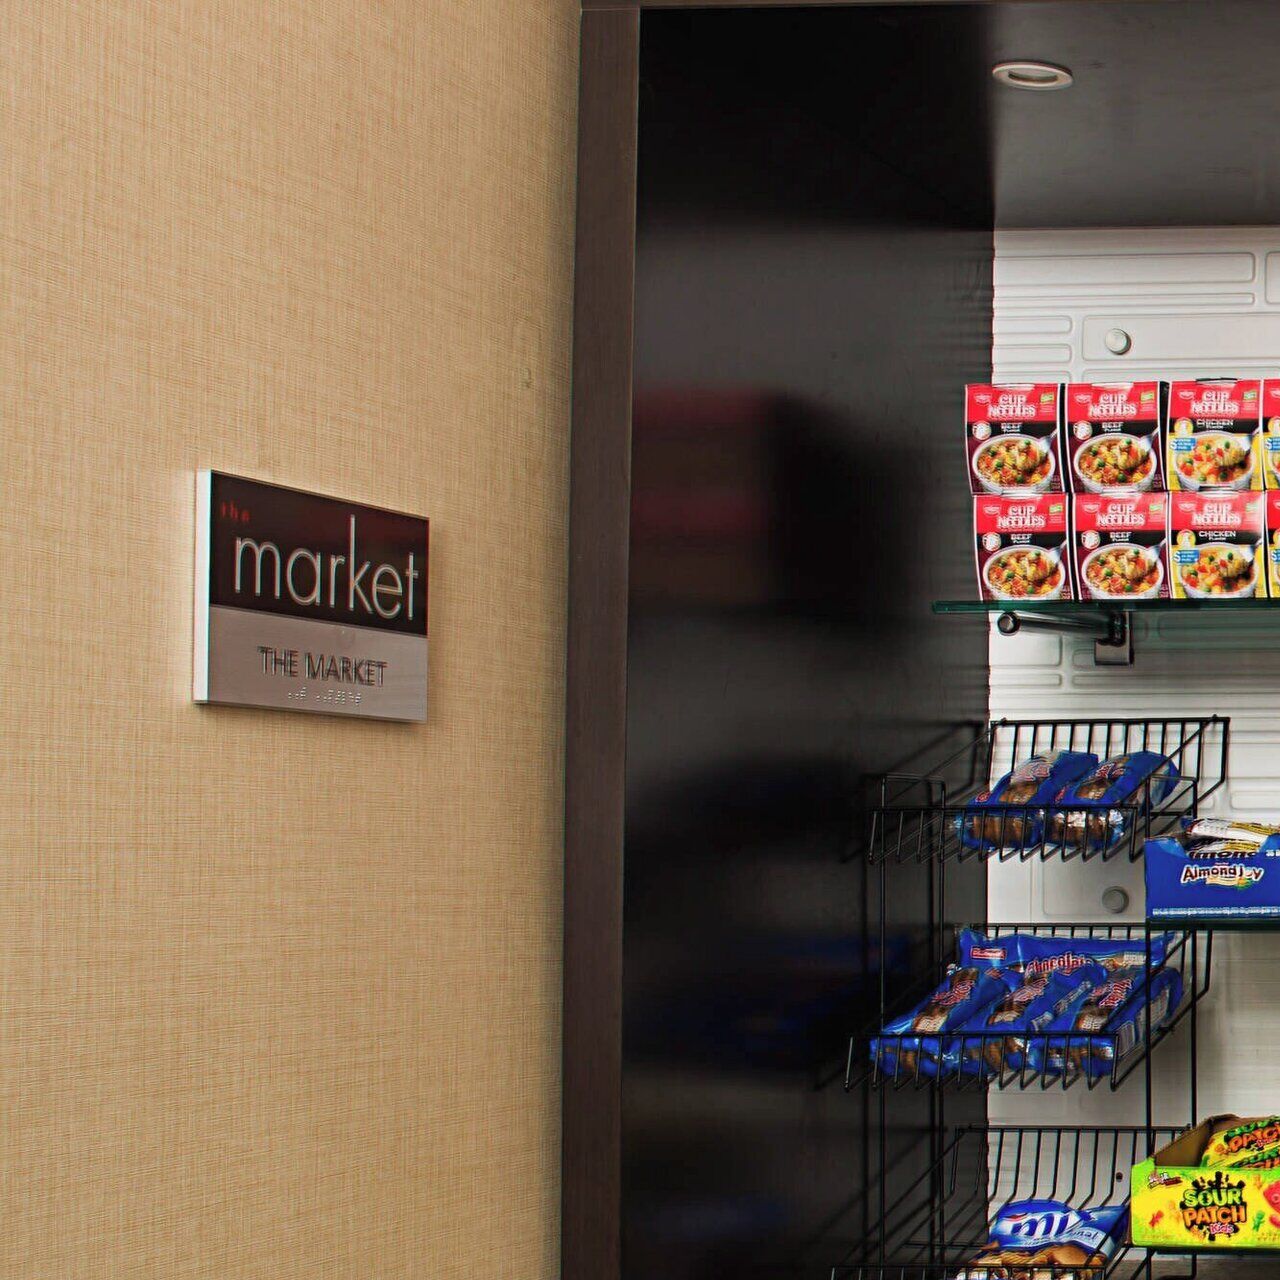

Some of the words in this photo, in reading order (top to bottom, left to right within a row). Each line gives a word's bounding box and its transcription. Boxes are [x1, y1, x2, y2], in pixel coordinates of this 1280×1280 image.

[999, 394, 1027, 405] CUP
[1100, 394, 1128, 405] CUP
[1191, 401, 1240, 415] NOODLES
[987, 404, 1037, 417] NOODLES
[219, 502, 250, 523] the
[1191, 512, 1241, 526] NOODLES
[234, 514, 419, 621] market
[258, 646, 299, 678] THE
[304, 652, 388, 688] MARKET
[1180, 864, 1238, 884] Almond
[1184, 1187, 1243, 1207] SOUR
[1181, 1205, 1247, 1225] PATCH
[1208, 1222, 1235, 1235] Kids
